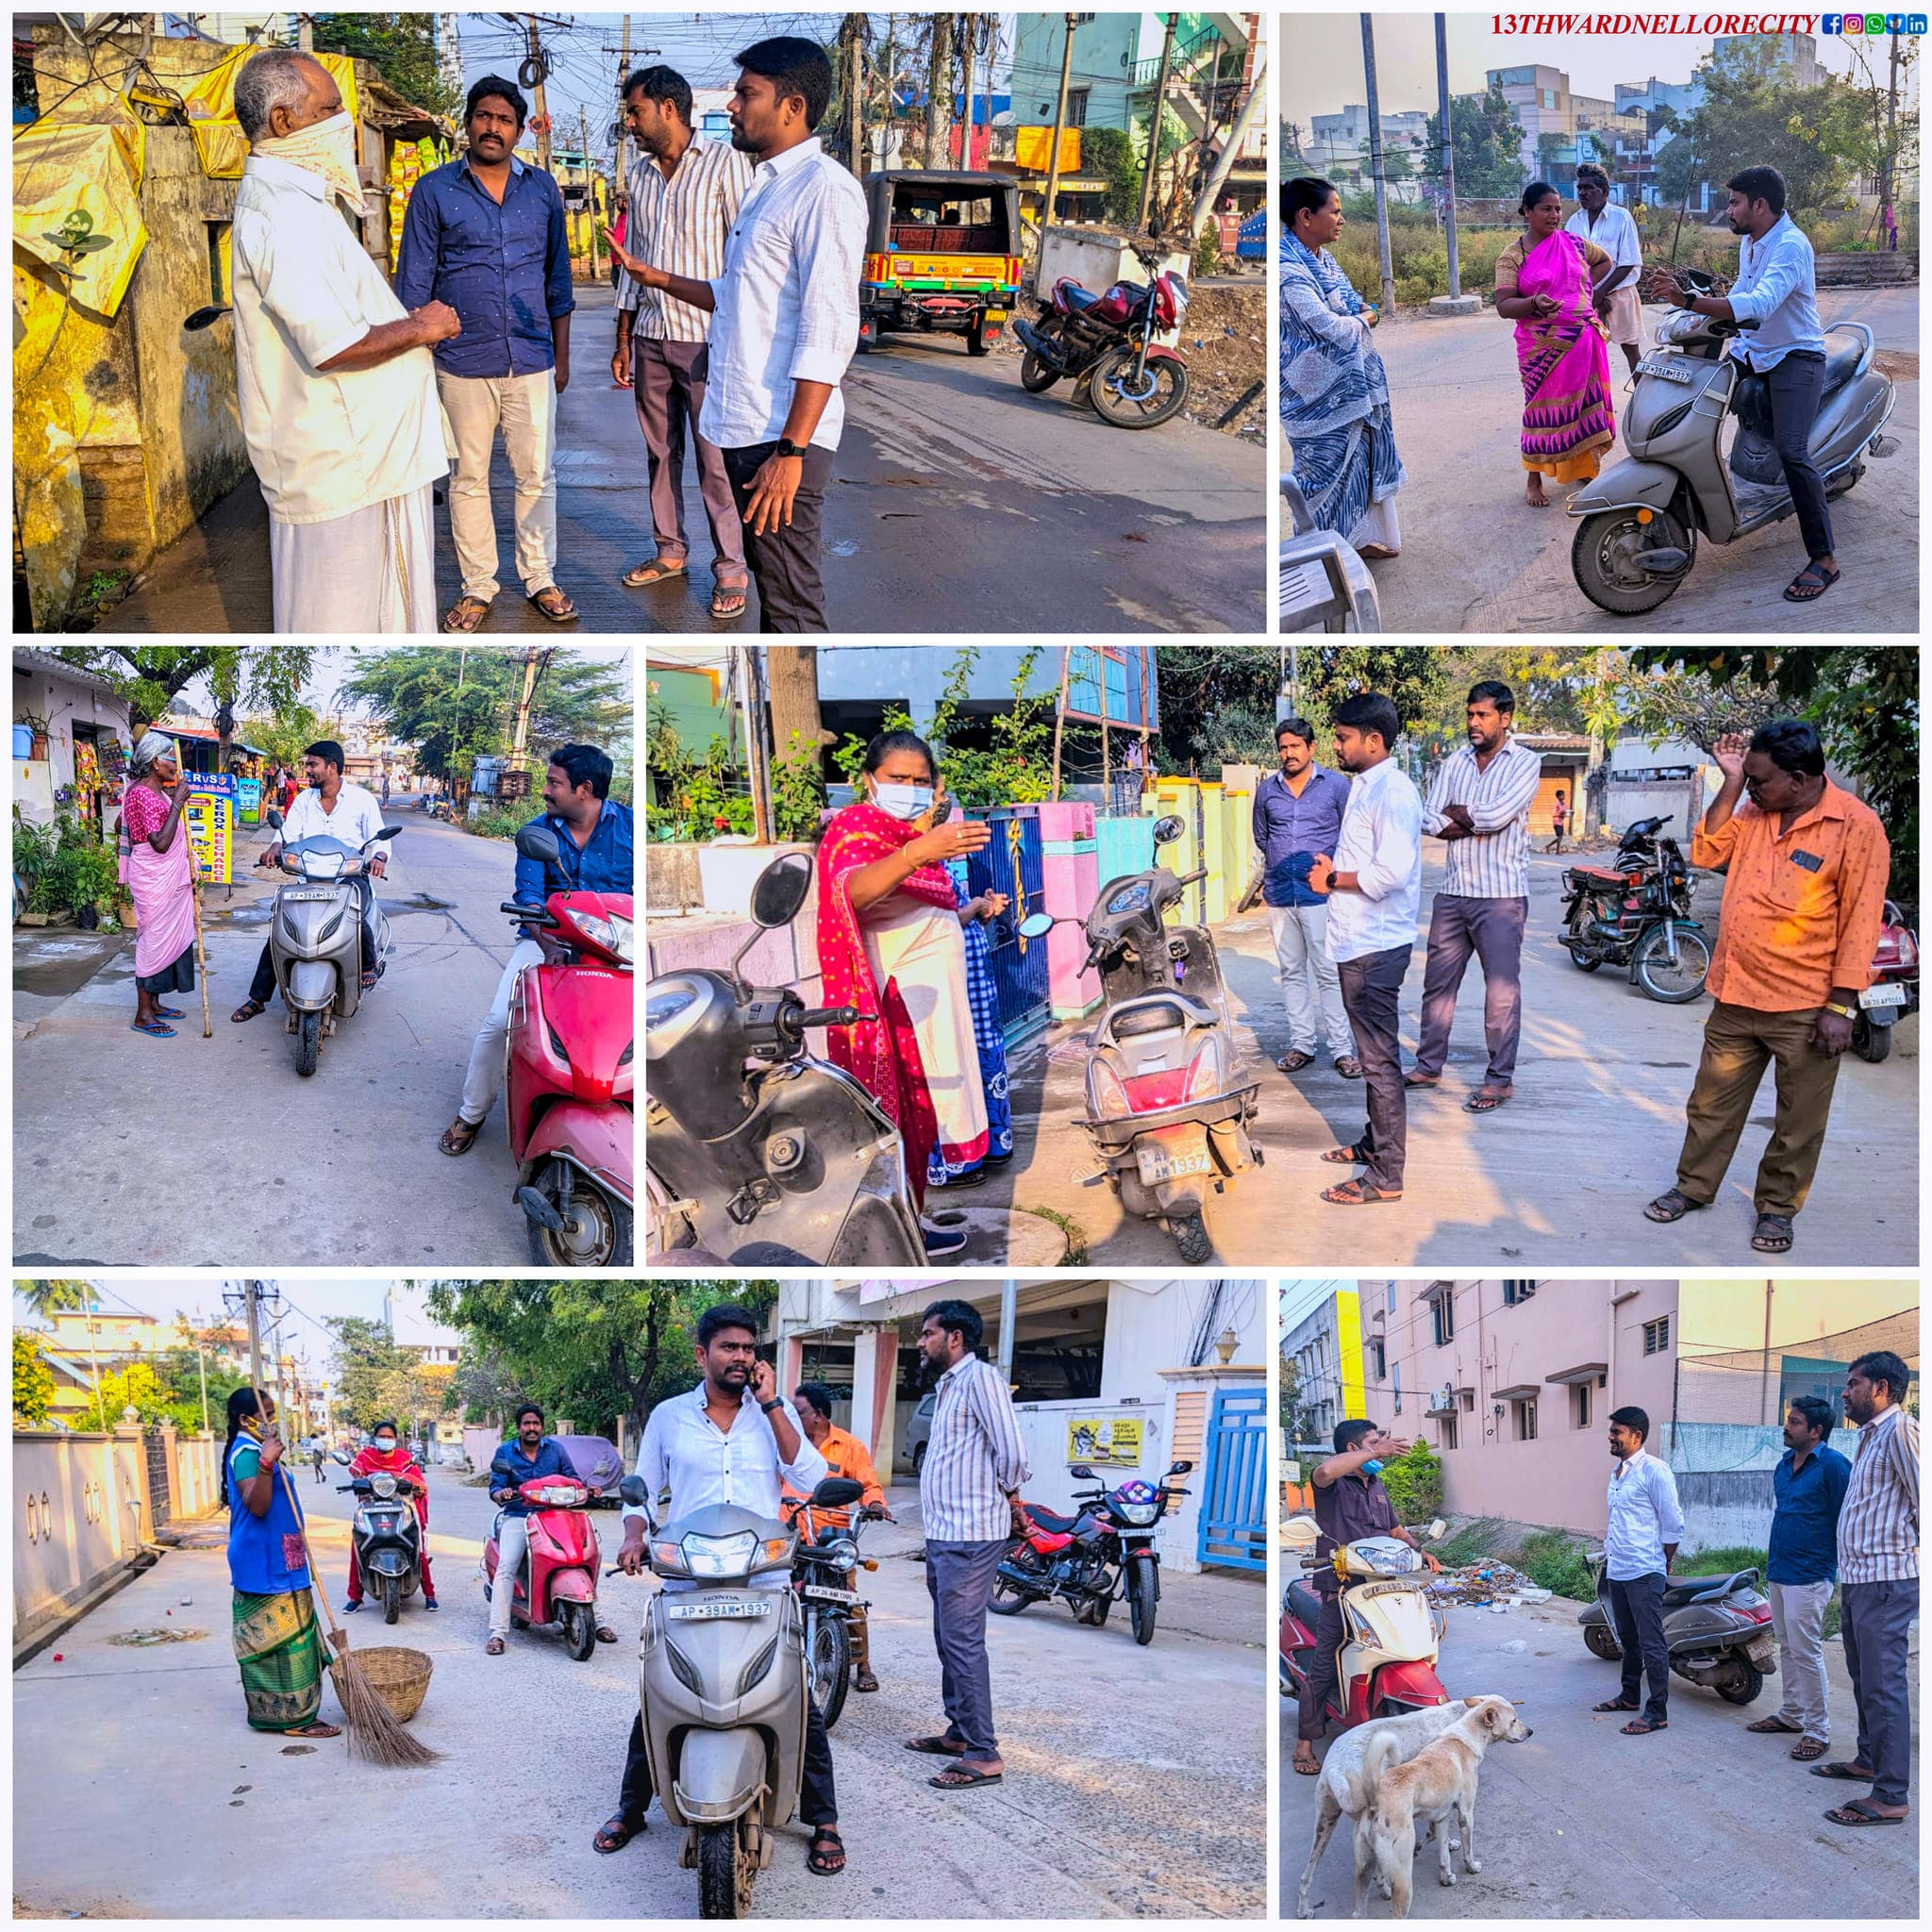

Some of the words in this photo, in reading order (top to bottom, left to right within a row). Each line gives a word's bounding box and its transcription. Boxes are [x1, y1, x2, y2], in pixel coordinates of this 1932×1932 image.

[214, 798, 225, 830] XEROX
[213, 832, 225, 882] RECHARGE
[575, 971, 614, 979] HONDA
[741, 1604, 771, 1615] 1937
